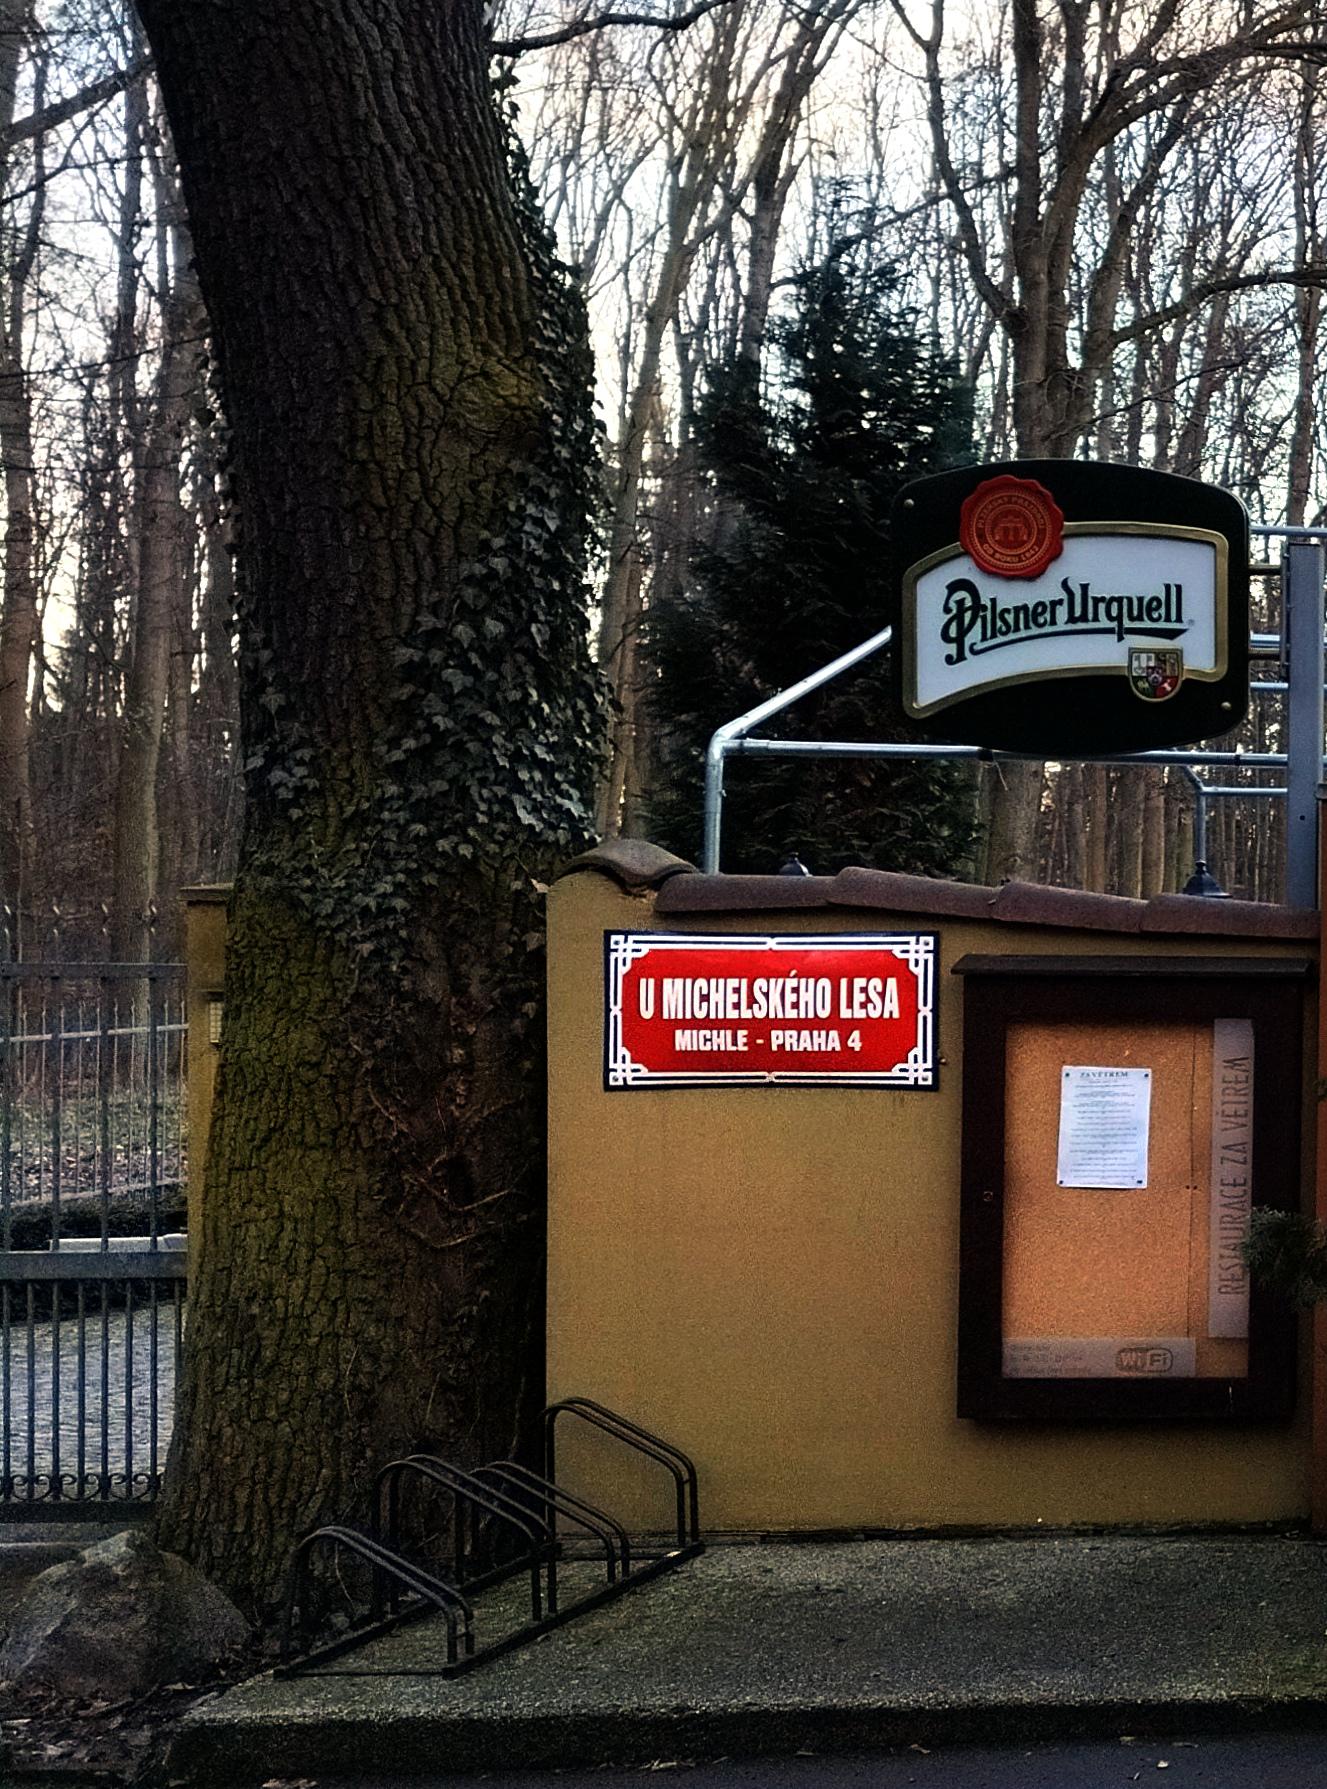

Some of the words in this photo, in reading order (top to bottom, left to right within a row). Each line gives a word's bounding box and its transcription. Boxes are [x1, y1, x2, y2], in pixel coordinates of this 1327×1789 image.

[940, 578, 1064, 666] Pilsner
[1061, 576, 1184, 643] Urquell
[639, 977, 655, 1020] U
[663, 969, 831, 1020] MICHELSKÉHO
[840, 977, 900, 1019] LESA
[674, 1029, 749, 1051] MICHLE
[771, 1029, 841, 1051] PRAHA
[847, 1029, 863, 1051] 4
[1215, 1056, 1250, 1132] VĚTREM
[1220, 1141, 1248, 1165] ZA
[1217, 1178, 1249, 1295] RESTAURACE
